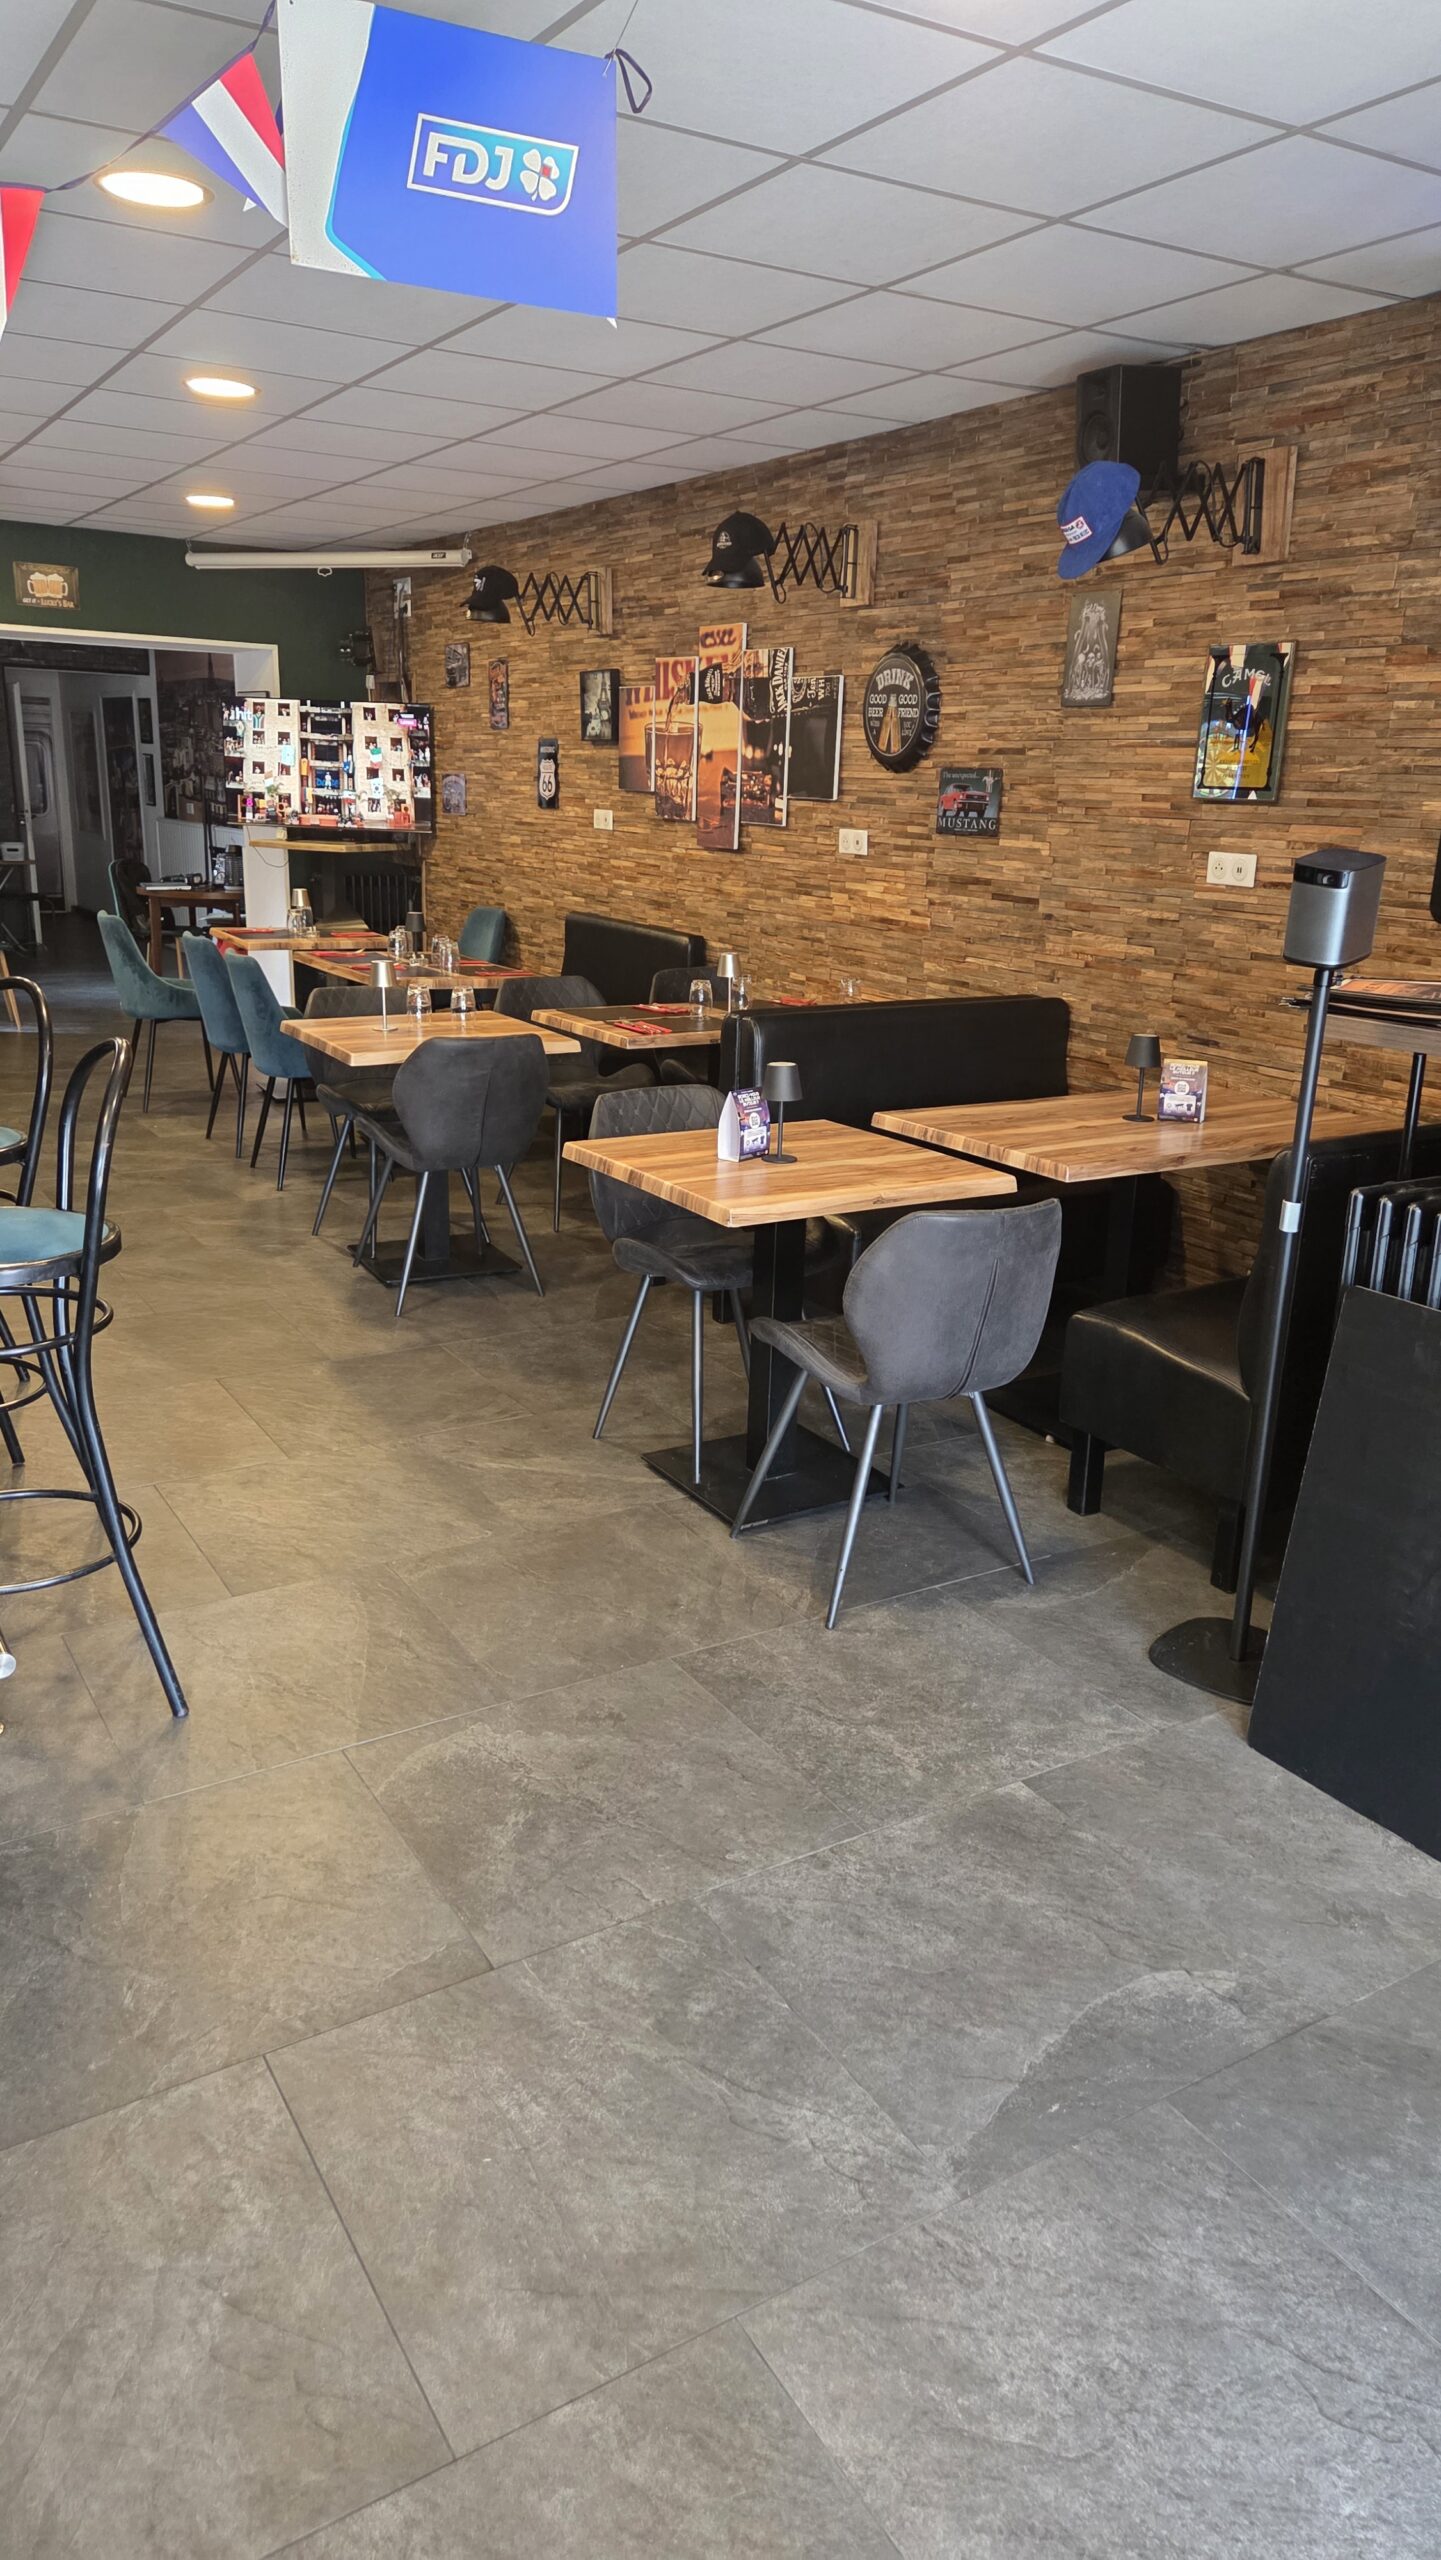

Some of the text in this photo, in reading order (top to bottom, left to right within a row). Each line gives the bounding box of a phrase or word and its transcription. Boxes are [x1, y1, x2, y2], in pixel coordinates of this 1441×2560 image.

[423, 131, 514, 191] FDJ
[876, 668, 914, 690] DRINK
[1221, 668, 1272, 688] CAMEL
[870, 694, 888, 704] GOOD
[898, 694, 918, 705] GOOD
[868, 707, 884, 717] BEER
[898, 707, 919, 718] FRIEND
[542, 775, 553, 793] 66
[938, 817, 997, 830] MUSTANG
